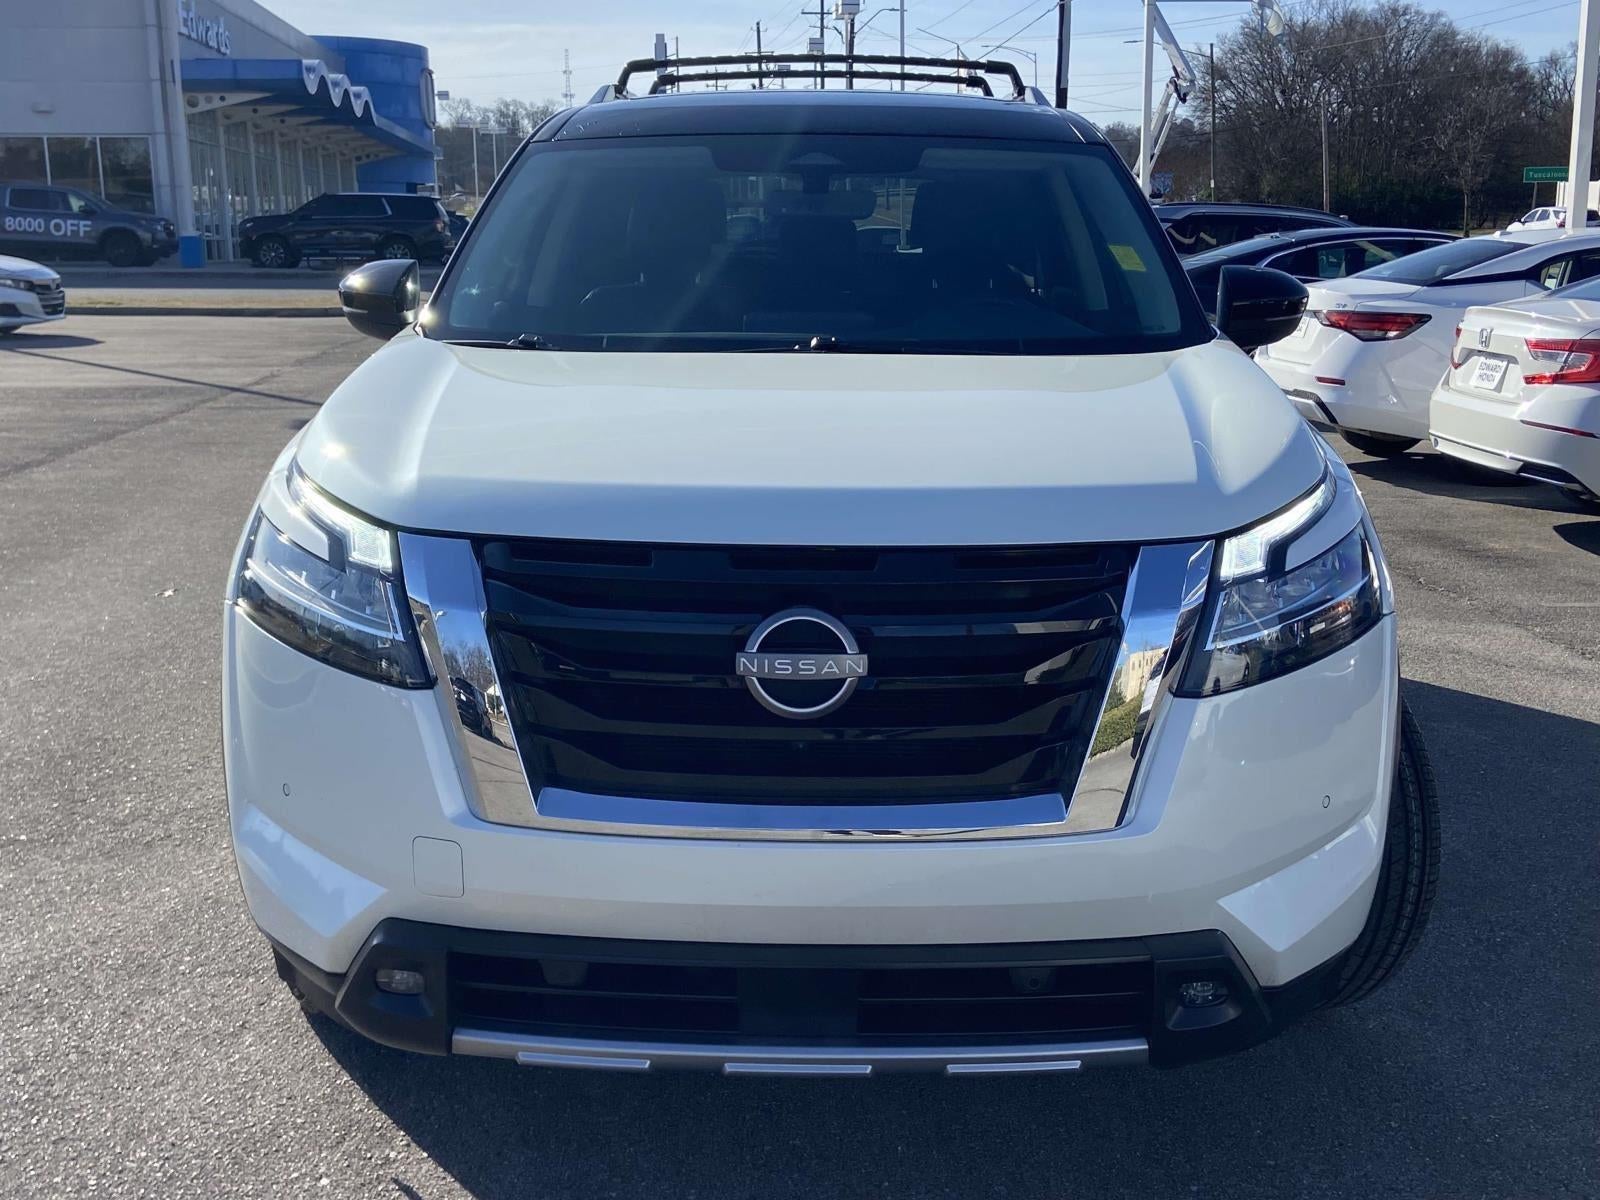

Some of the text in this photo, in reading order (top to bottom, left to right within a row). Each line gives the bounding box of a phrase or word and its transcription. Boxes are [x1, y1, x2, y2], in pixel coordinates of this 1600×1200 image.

[178, 0, 231, 54] Edwards
[4, 216, 92, 237] 8000 OFF
[739, 657, 864, 675] NISSAN
